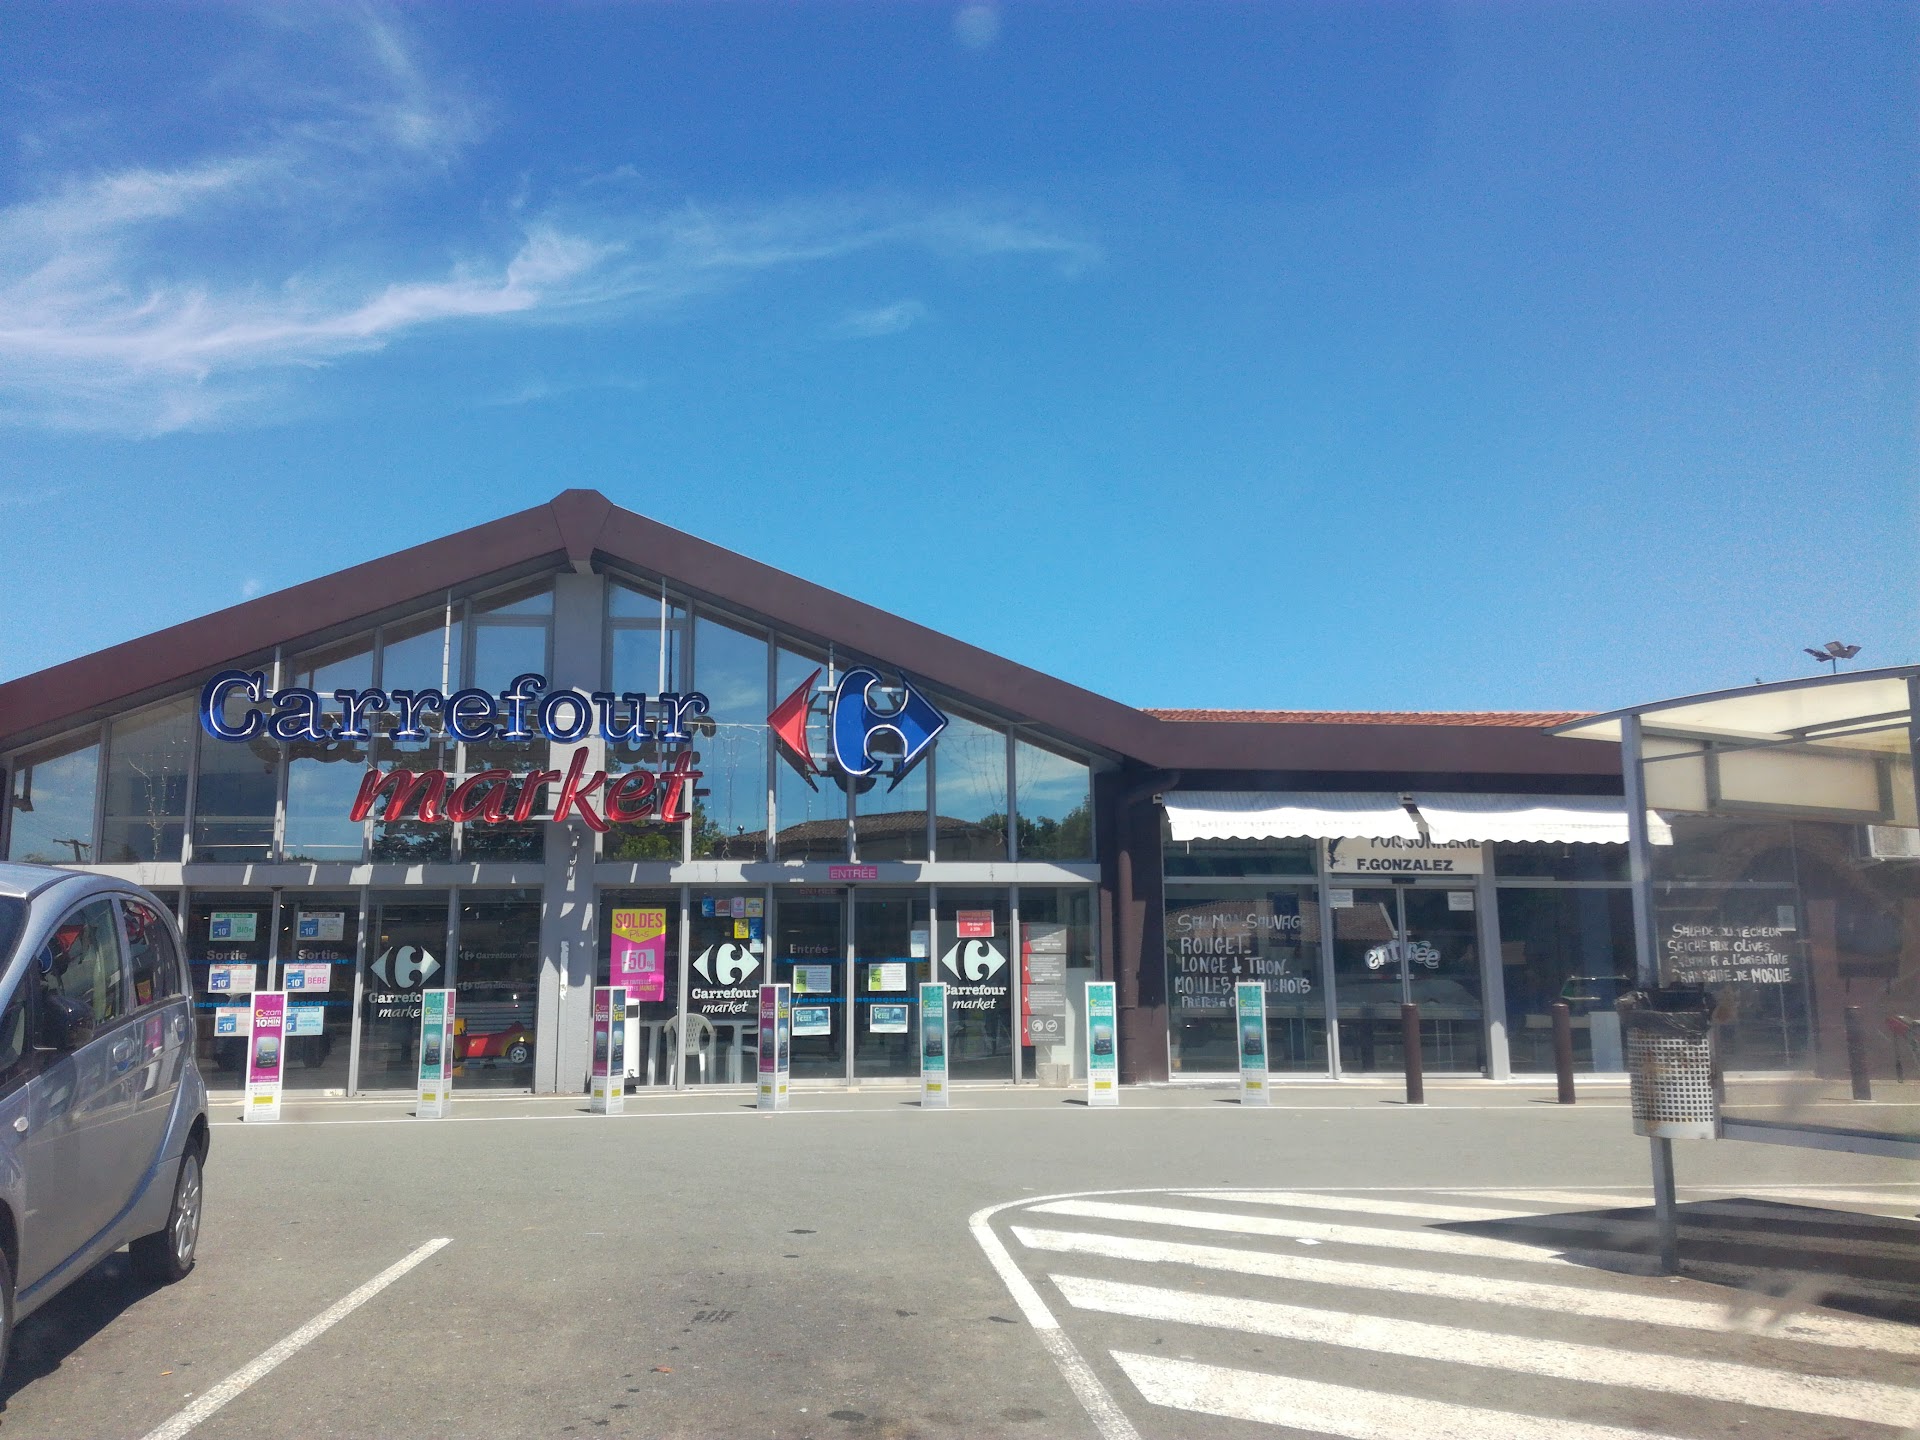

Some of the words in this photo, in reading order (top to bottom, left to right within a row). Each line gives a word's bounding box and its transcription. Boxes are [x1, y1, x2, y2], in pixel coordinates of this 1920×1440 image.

[200, 669, 709, 743] Carrefour
[350, 746, 704, 833] market
[1357, 858, 1453, 871] F.GONZALEZ
[830, 866, 876, 879] ENTRÉE
[615, 913, 663, 929] SOLDES
[297, 949, 339, 960] Sortie
[790, 943, 829, 954] Entrée
[206, 950, 248, 961] Sortie
[368, 992, 423, 1004] Carrefo
[692, 987, 759, 999] Carrefour
[701, 1000, 749, 1014] market
[952, 997, 997, 1011] market
[255, 1009, 282, 1017] C-zam
[378, 1005, 421, 1018] marke
[255, 1019, 267, 1028] 10
